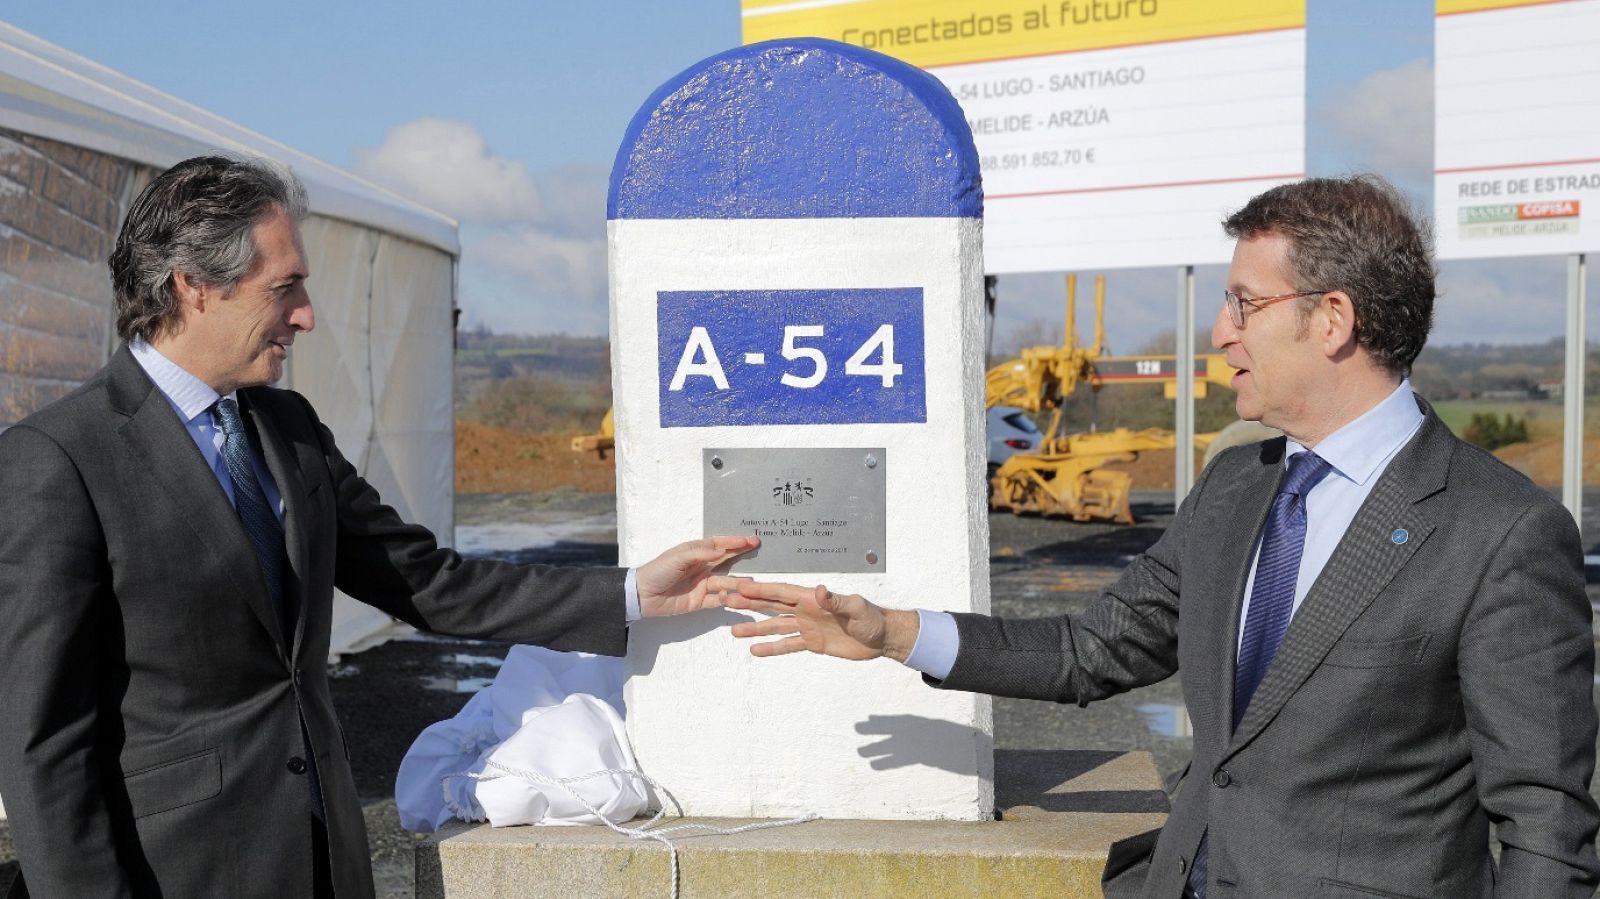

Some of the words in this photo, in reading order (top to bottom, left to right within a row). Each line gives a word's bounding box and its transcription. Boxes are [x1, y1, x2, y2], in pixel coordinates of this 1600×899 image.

[842, 12, 1013, 49] Conectados
[1024, 4, 1050, 30] al
[1060, 0, 1158, 26] futuro
[983, 77, 1034, 100] LUGO
[1049, 65, 1146, 92] SANTIAGO
[970, 113, 1033, 136] MELIDE
[1048, 105, 1111, 129] ARZÚA
[1085, 148, 1096, 163] €
[1459, 182, 1502, 198] REDE
[1507, 179, 1529, 195] DE
